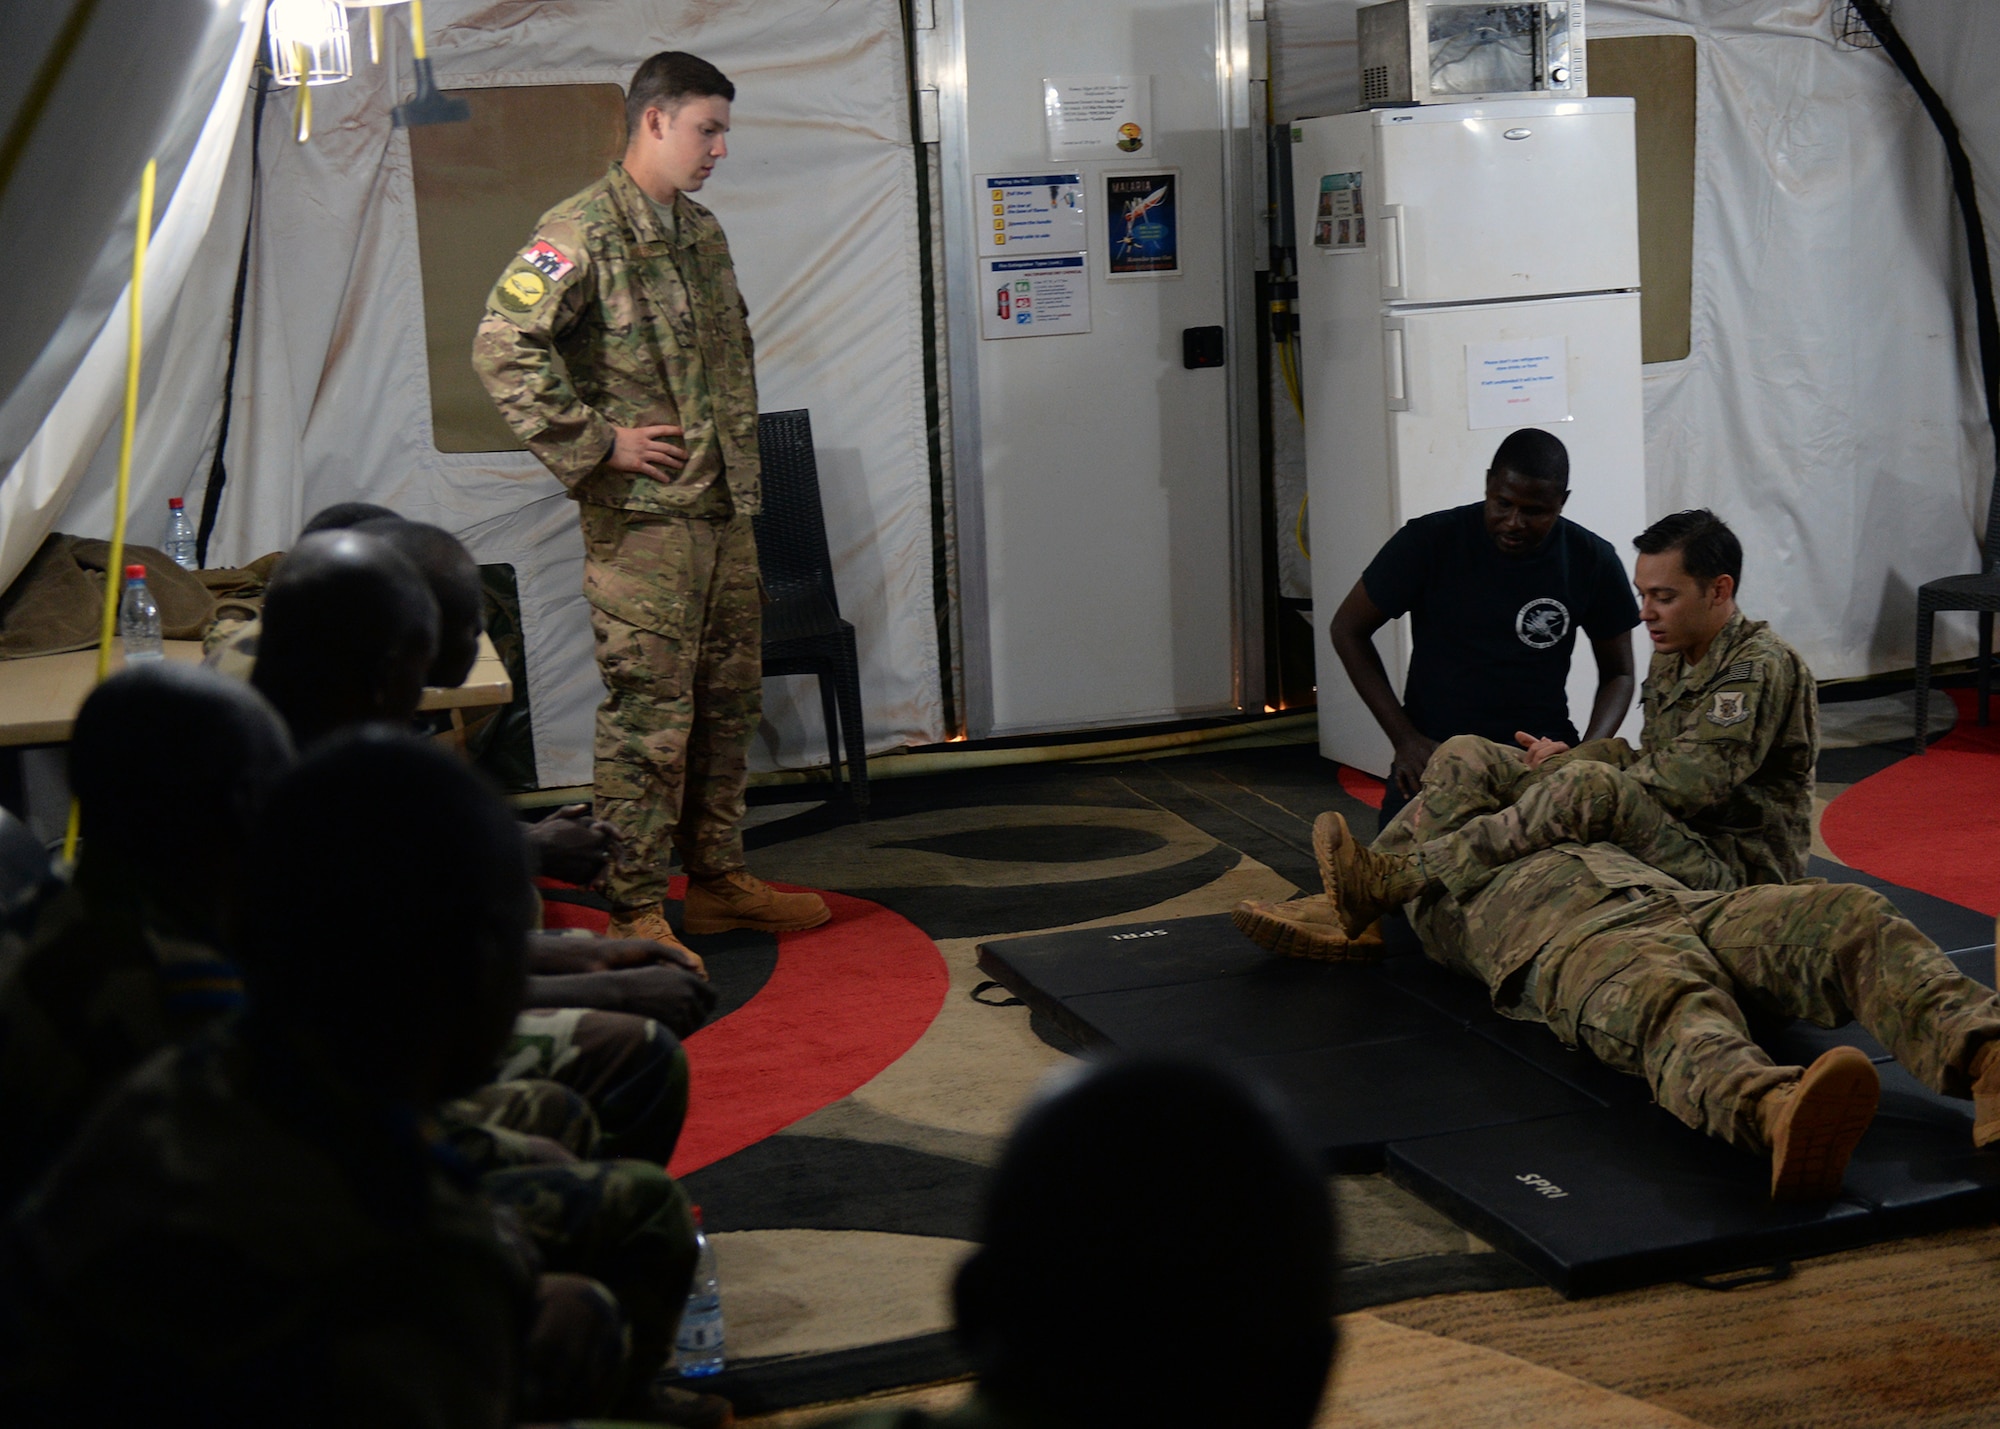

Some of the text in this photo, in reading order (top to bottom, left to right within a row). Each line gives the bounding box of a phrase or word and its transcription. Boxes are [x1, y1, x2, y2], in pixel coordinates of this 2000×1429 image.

[1111, 180, 1152, 192] MALARIA
[1108, 929, 1168, 940] SPRI
[1515, 1173, 1568, 1198] SPRI
